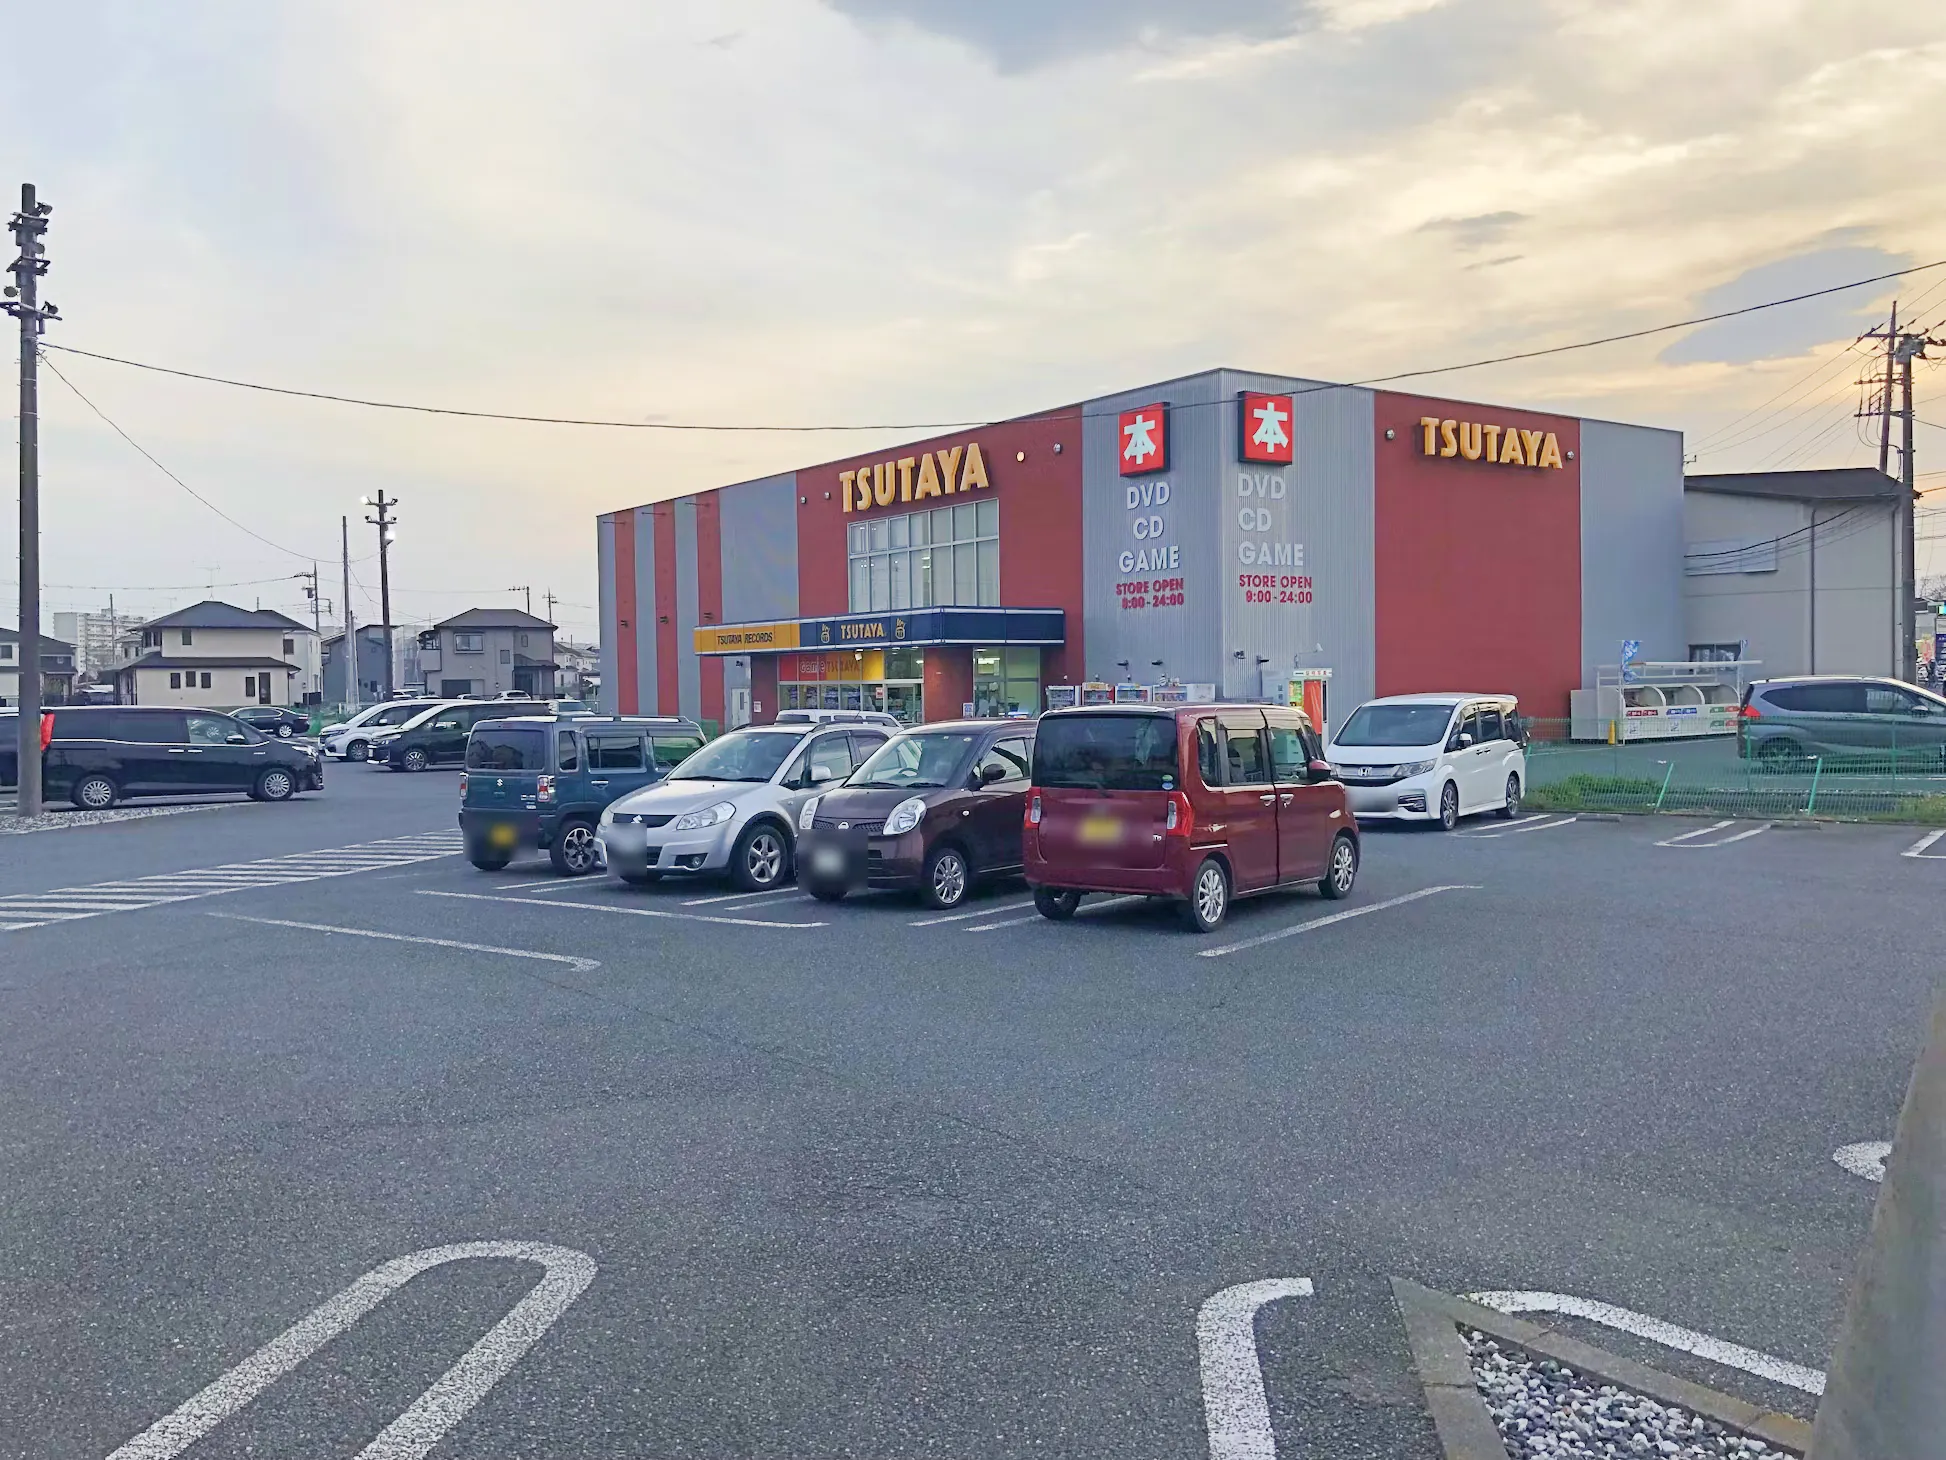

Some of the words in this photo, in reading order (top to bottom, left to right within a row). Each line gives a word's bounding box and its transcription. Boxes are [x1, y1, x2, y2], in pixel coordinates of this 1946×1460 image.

[1123, 414, 1157, 465] 本
[1252, 401, 1289, 453] 本
[1420, 416, 1563, 469] TSUTAYA
[838, 442, 990, 513] TSUTAYA
[1237, 472, 1286, 500] DVD
[1126, 481, 1170, 510] DVD
[1133, 515, 1164, 540] CD
[1237, 507, 1272, 532] CD
[1118, 545, 1180, 573] GAME
[1238, 540, 1304, 567] GAME
[1115, 581, 1150, 596] STORE
[1152, 577, 1184, 592] OPEN
[1239, 574, 1276, 588] STORE
[1280, 575, 1312, 589] OPEN
[716, 634, 742, 645] TSUTAYA
[744, 632, 773, 644] RECORDS
[840, 622, 884, 640] TSUTAYA
